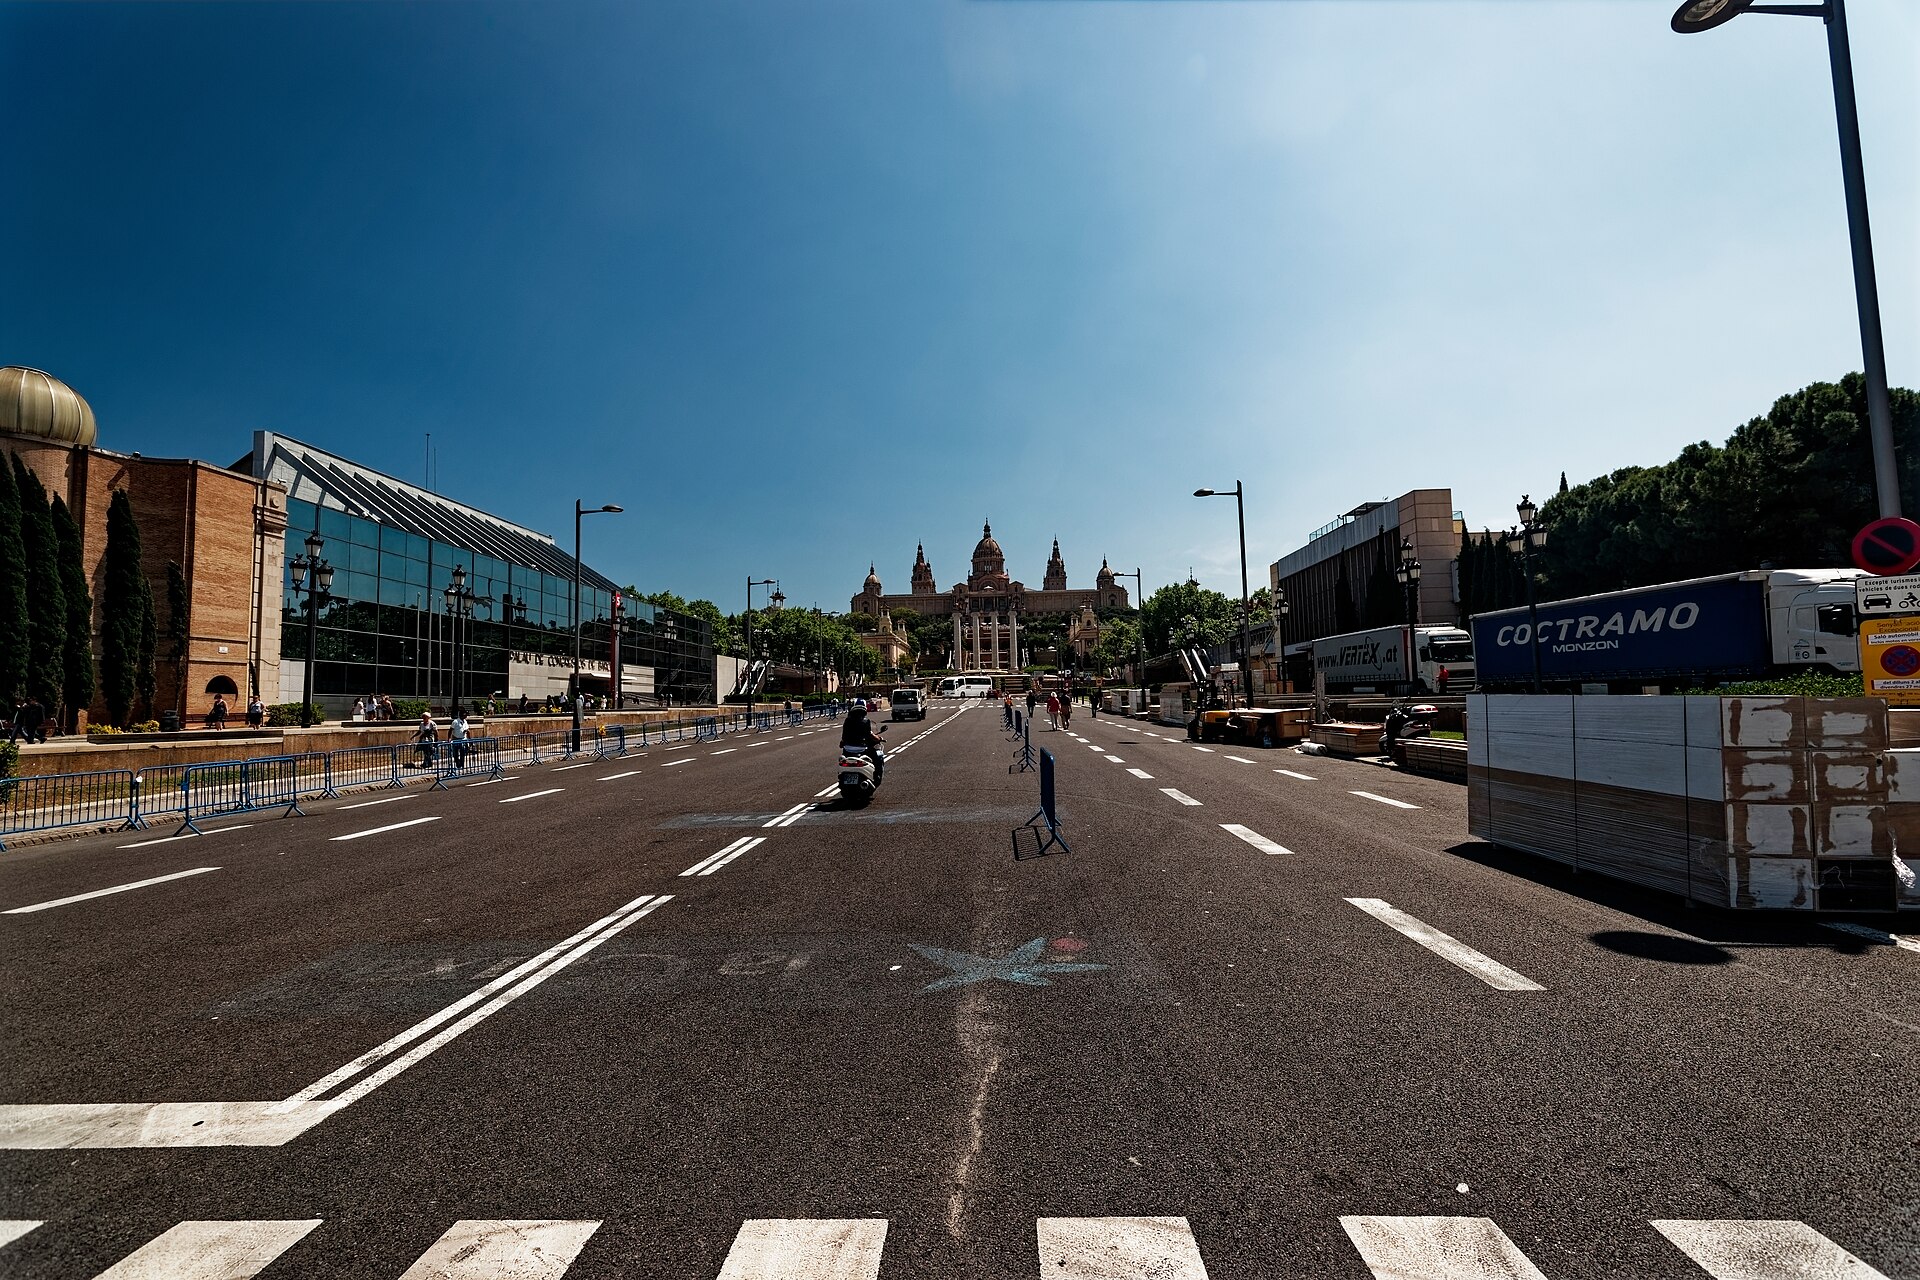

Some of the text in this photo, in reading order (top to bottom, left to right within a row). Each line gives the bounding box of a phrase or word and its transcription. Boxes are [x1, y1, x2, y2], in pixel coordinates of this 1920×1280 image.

[1497, 602, 1700, 646] COCTRAMO
[1552, 639, 1619, 653] MONZON
[535, 653, 543, 666] DE
[1064, 669, 1072, 678] P
